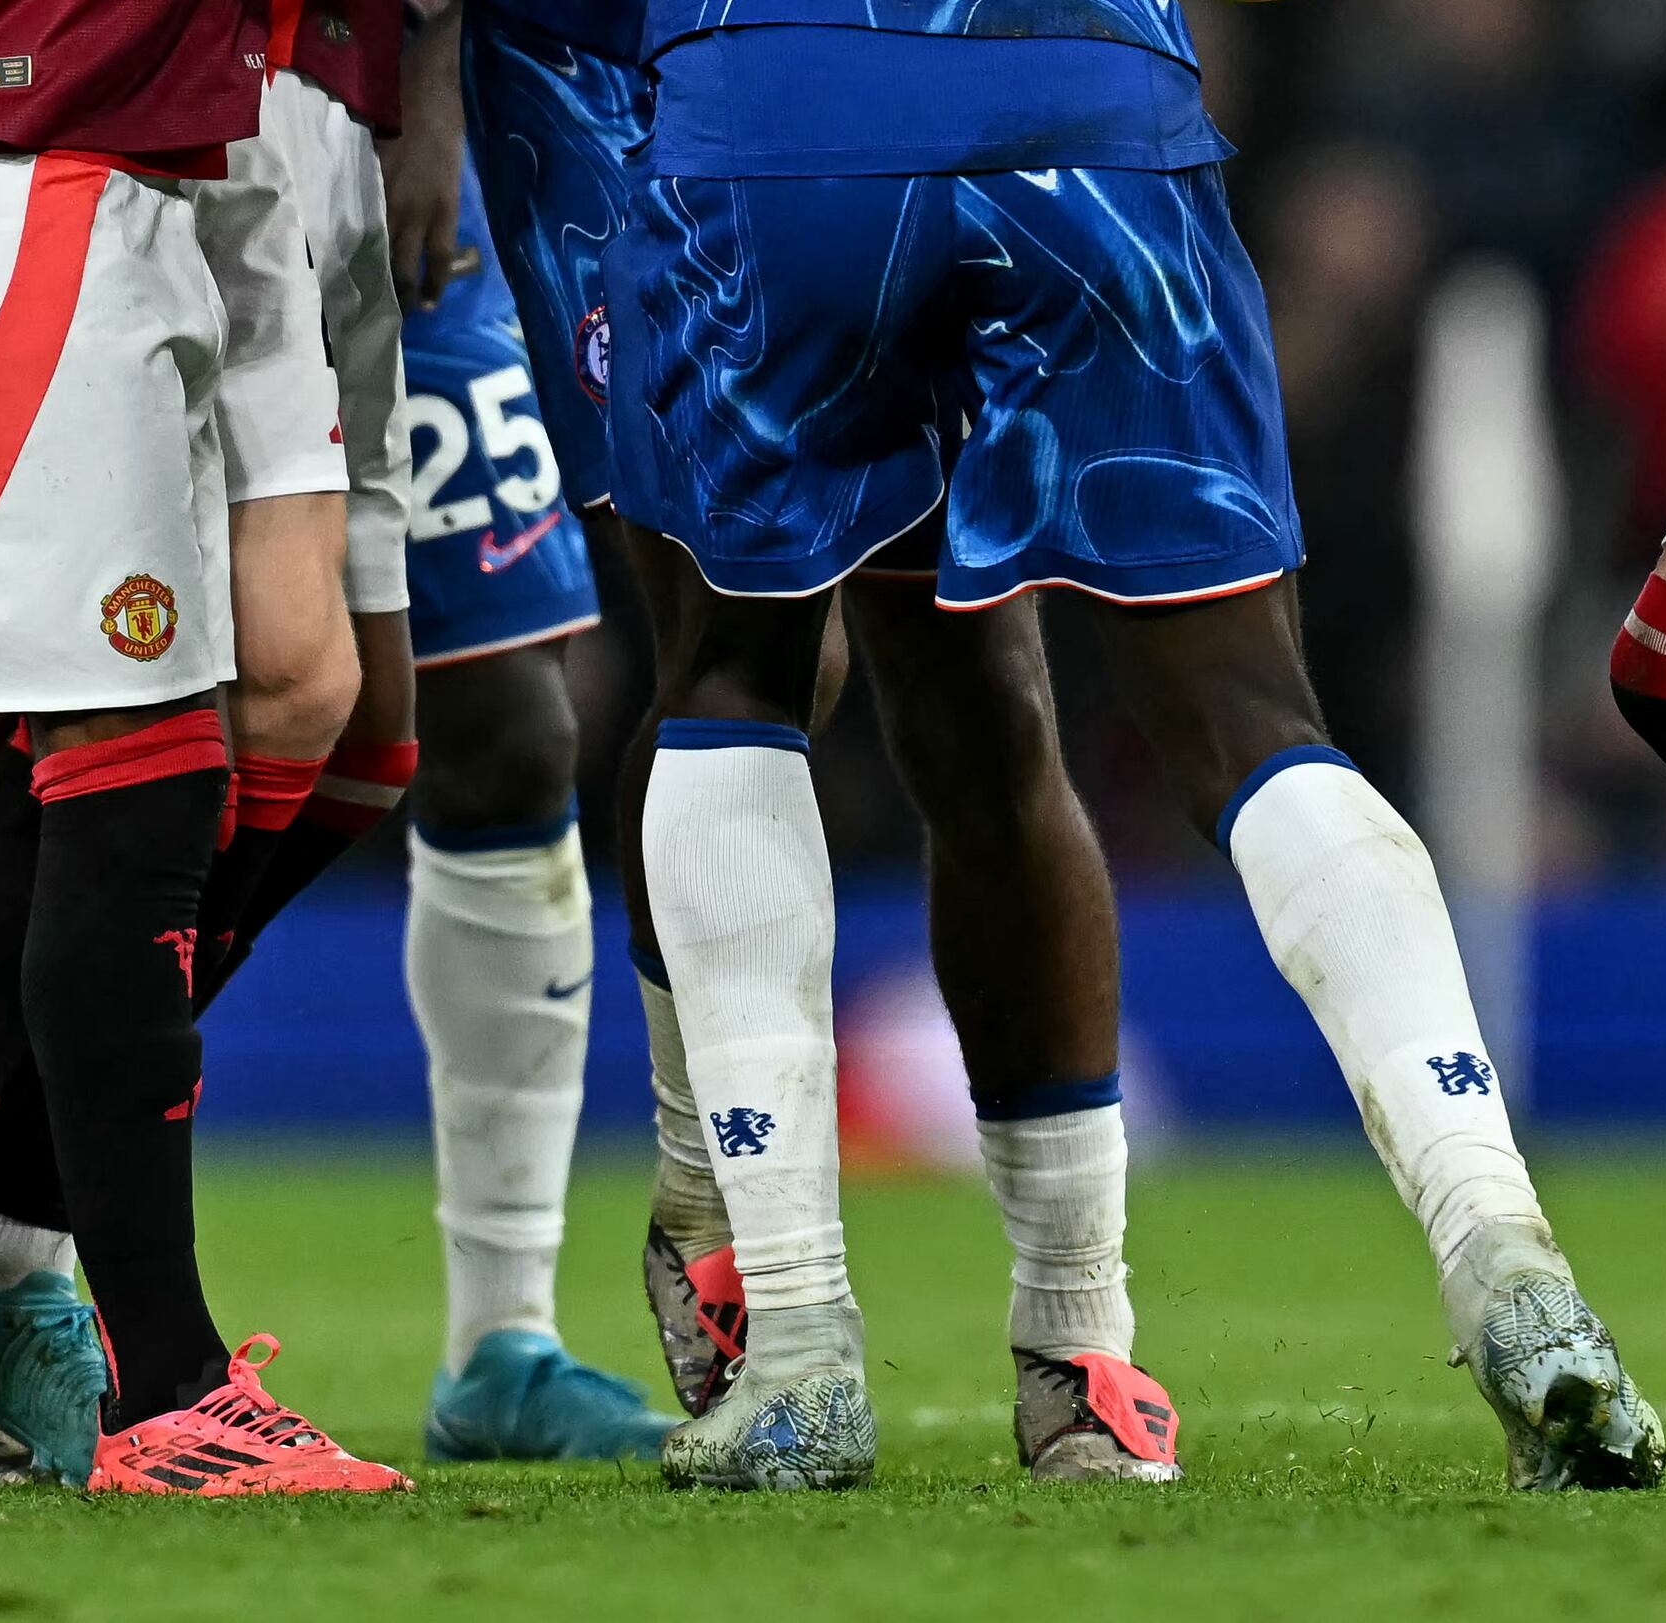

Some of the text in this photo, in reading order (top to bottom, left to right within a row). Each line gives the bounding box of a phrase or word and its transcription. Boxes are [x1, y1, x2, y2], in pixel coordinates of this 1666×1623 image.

[407, 364, 561, 542] 25
[108, 580, 172, 613] MANCHESTER
[124, 637, 168, 655] UNITED
